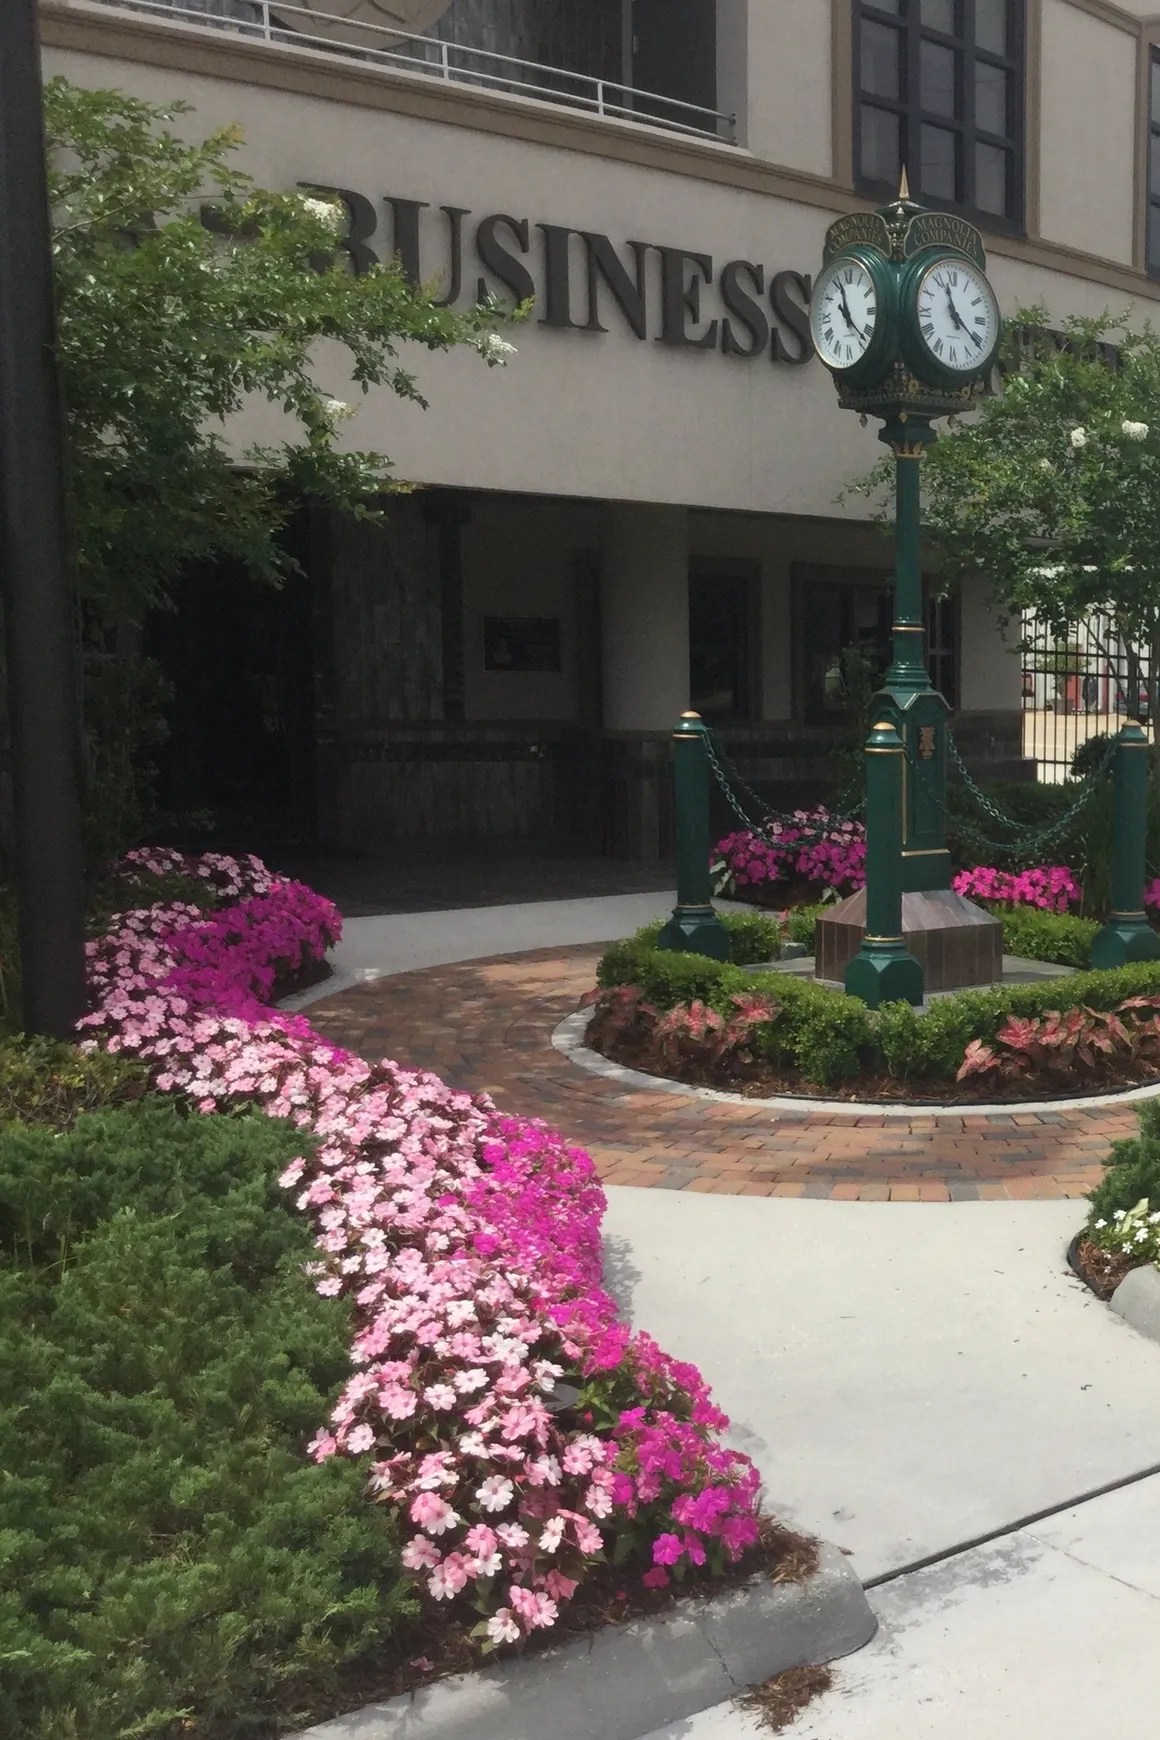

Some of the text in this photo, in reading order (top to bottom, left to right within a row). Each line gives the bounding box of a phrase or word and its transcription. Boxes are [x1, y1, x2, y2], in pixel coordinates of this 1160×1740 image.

[829, 214, 881, 237] MAGNOLIA
[916, 216, 978, 245] MAGNOLIA
[829, 227, 883, 254] COMPANIES
[914, 227, 978, 256] COMPANIES
[297, 182, 813, 365] BUSINESS
[822, 312, 832, 325] IX
[919, 304, 932, 318] IX
[974, 316, 986, 327] III
